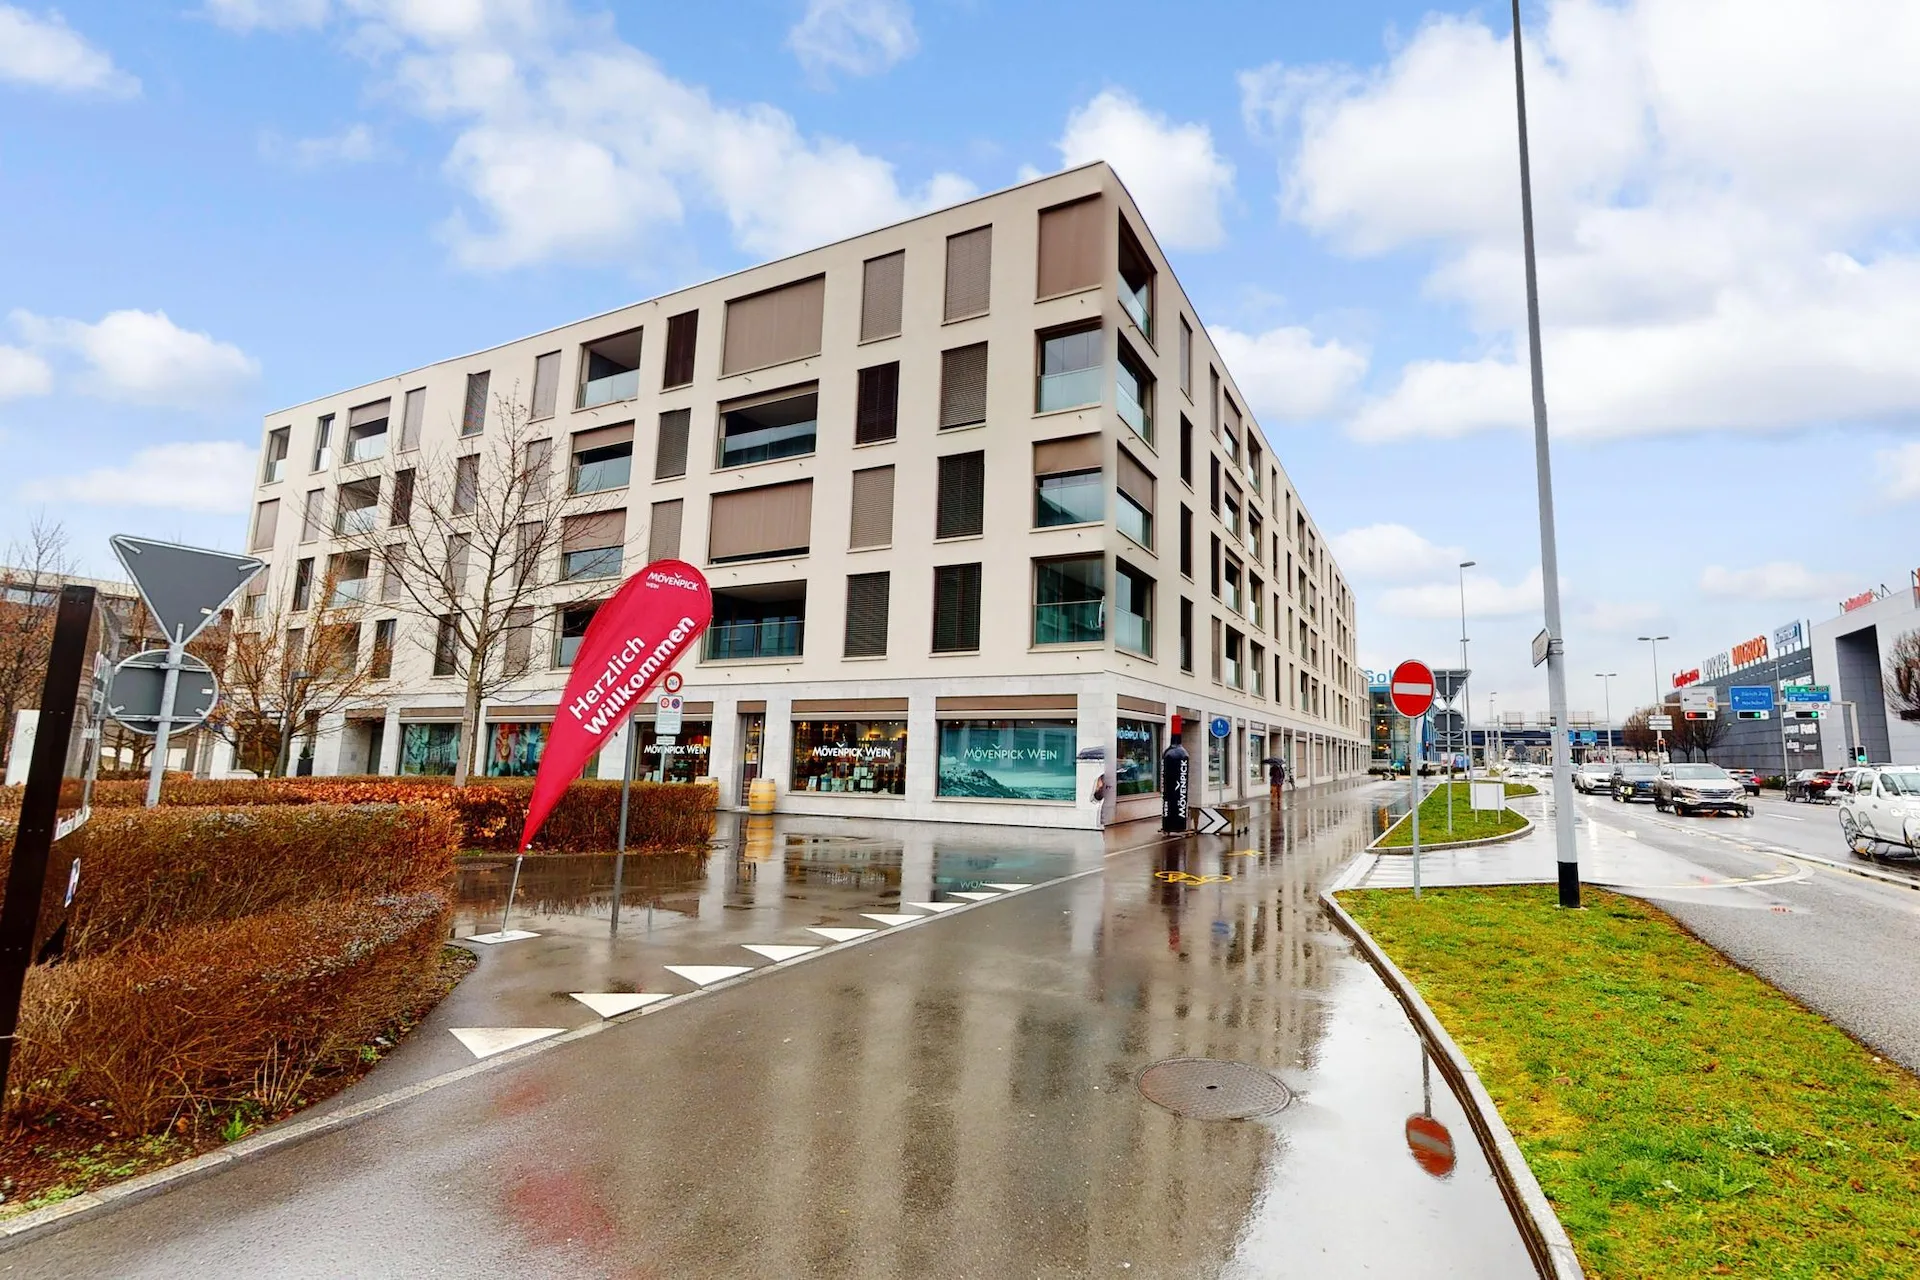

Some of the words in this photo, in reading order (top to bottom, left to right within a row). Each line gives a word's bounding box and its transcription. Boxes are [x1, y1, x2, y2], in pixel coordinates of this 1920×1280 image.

[647, 572, 699, 592] MÖVENPICK
[569, 636, 646, 720] Herzlich
[583, 616, 696, 735] Willkommen
[643, 744, 685, 754] MÖVNPICK
[686, 744, 707, 754] WEIN
[812, 742, 862, 757] MÖVENPICK
[865, 746, 891, 759] WEIN
[963, 744, 1024, 760] MÖVENPICK
[1027, 748, 1057, 760] WEIN
[1178, 759, 1188, 818] MÖVENPICK
